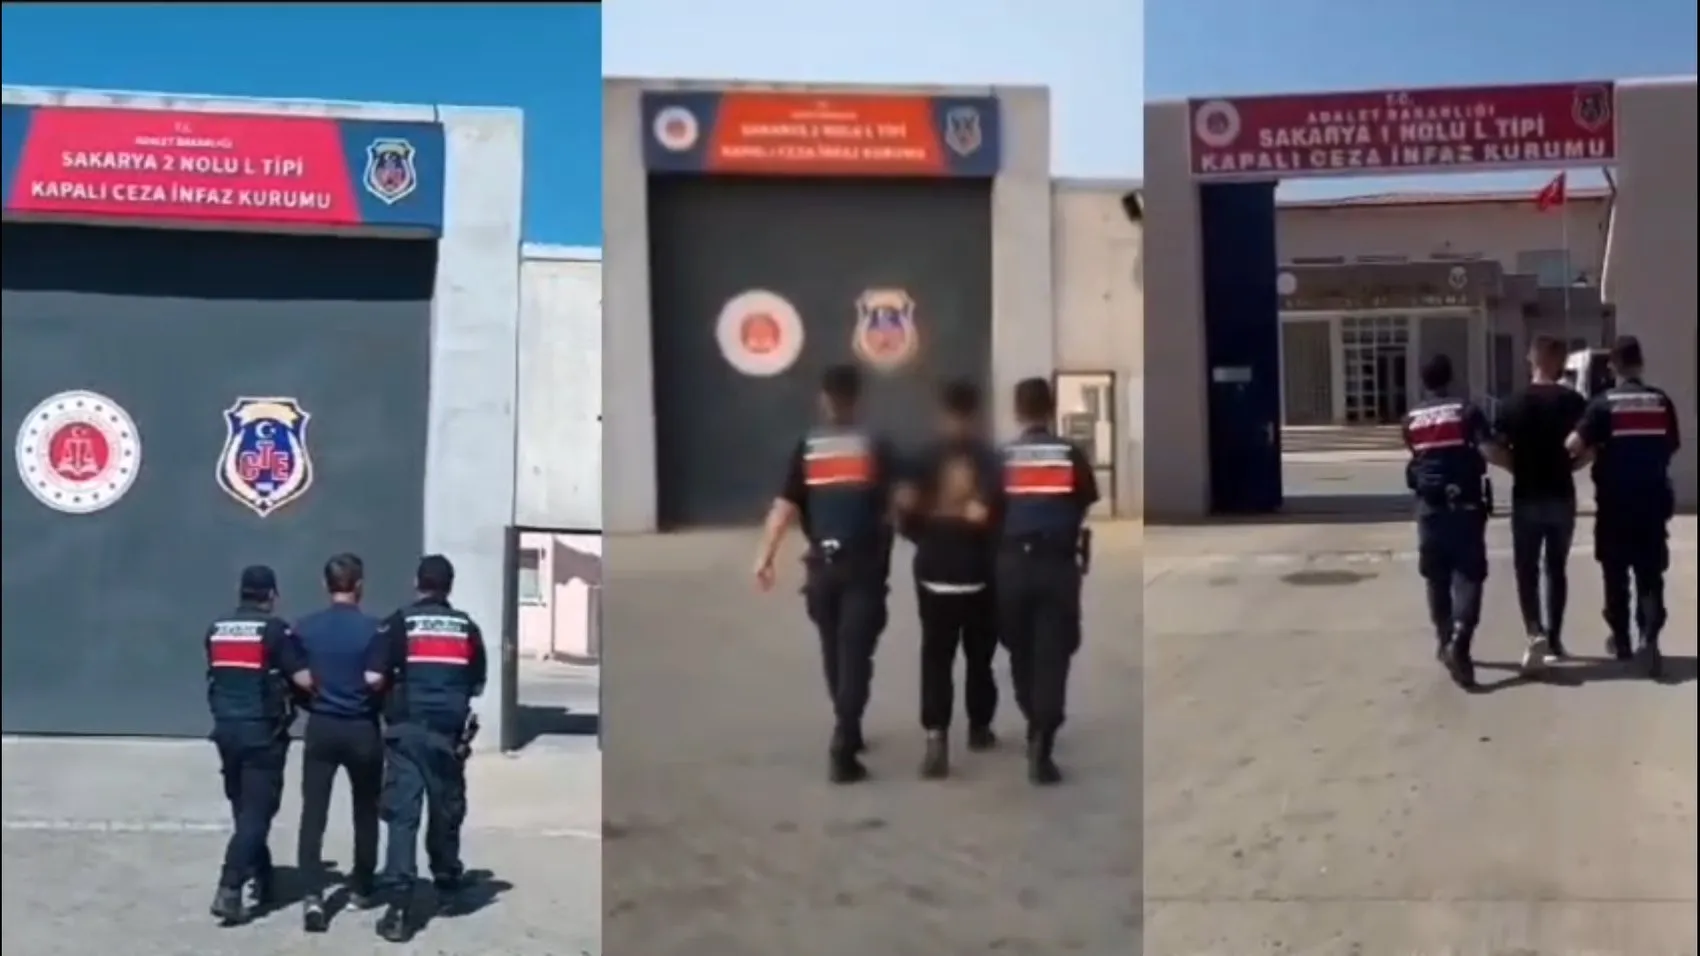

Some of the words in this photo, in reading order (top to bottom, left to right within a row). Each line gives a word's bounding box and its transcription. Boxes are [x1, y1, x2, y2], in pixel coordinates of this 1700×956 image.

[1307, 108, 1380, 123] ADALET
[1259, 124, 1371, 148] SAKARYA
[1400, 119, 1466, 142] NOLU
[1474, 119, 1488, 139] L
[61, 151, 157, 170] SAKARYA
[163, 153, 175, 171] 2
[180, 155, 239, 174] NOLU
[244, 156, 256, 174] L
[260, 154, 304, 177] TİPİ
[1201, 152, 1300, 171] KAPALI
[1309, 147, 1382, 167] CEZA
[1484, 138, 1606, 161] KURUMU
[30, 179, 107, 199] KAPALI
[112, 182, 167, 202] CEZA
[171, 181, 233, 205] İNFAZ
[238, 189, 332, 209] KURUMU
